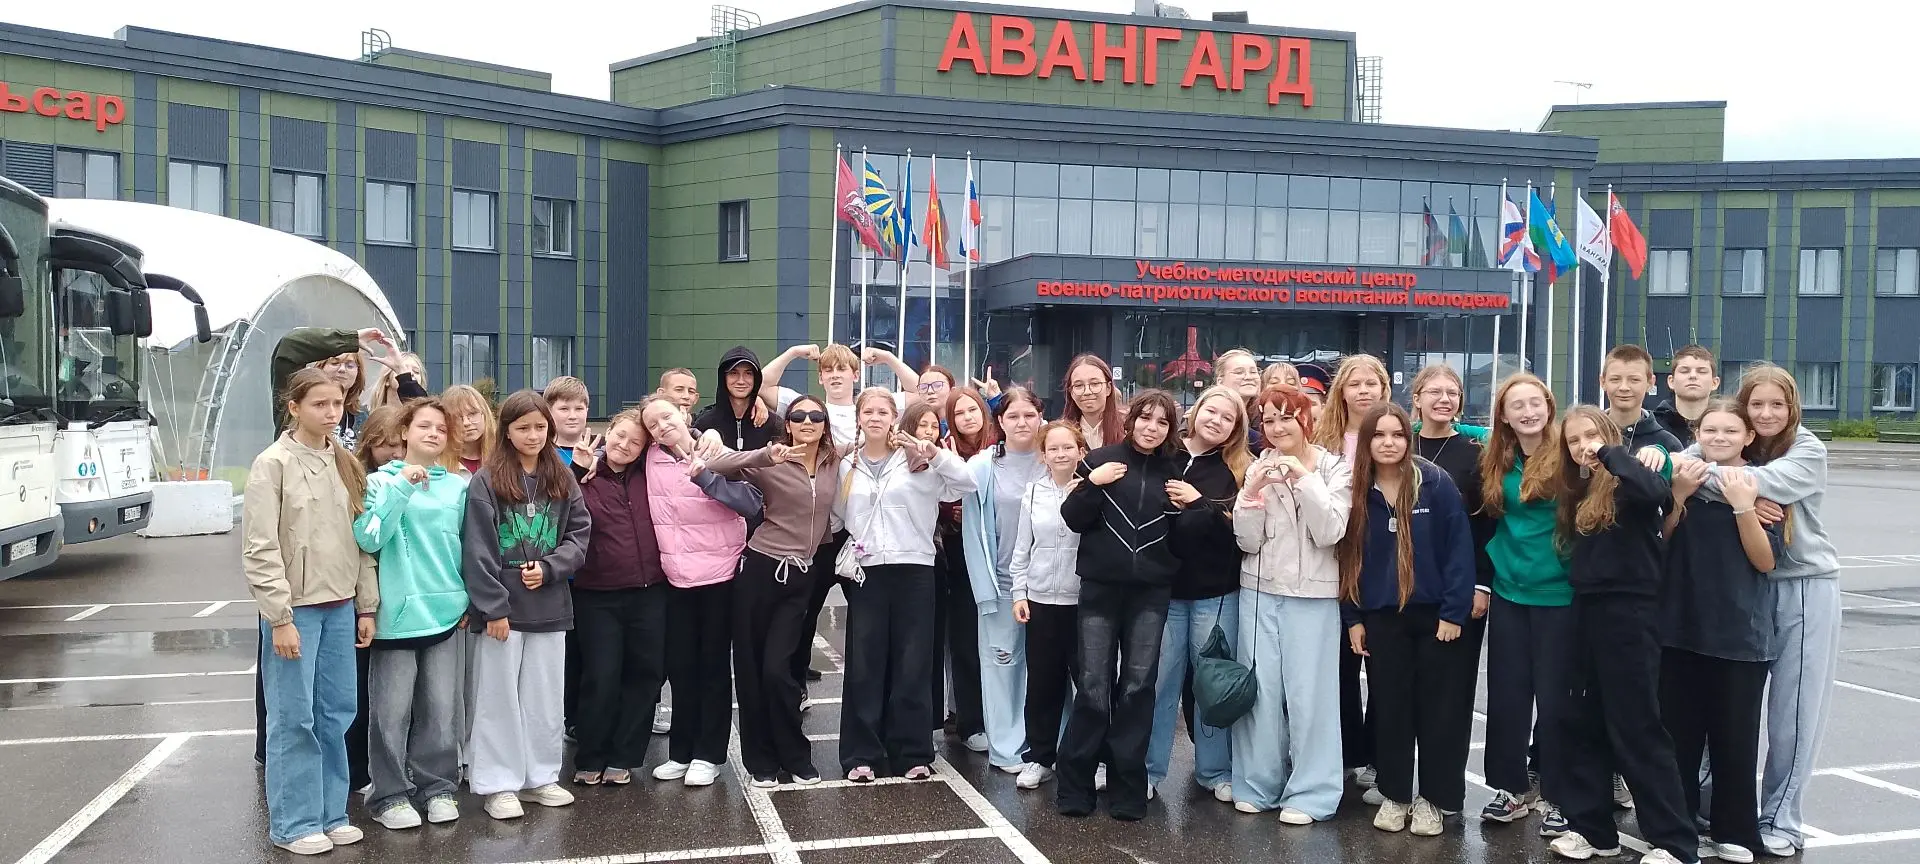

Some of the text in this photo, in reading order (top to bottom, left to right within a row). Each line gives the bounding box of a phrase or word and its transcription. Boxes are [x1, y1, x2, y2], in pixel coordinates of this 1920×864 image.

[937, 11, 1314, 108] АВАНГАРД
[1136, 260, 1417, 290] Учебно-методический центр
[1036, 281, 1510, 309] военно-патриотического воспитания молодежи
